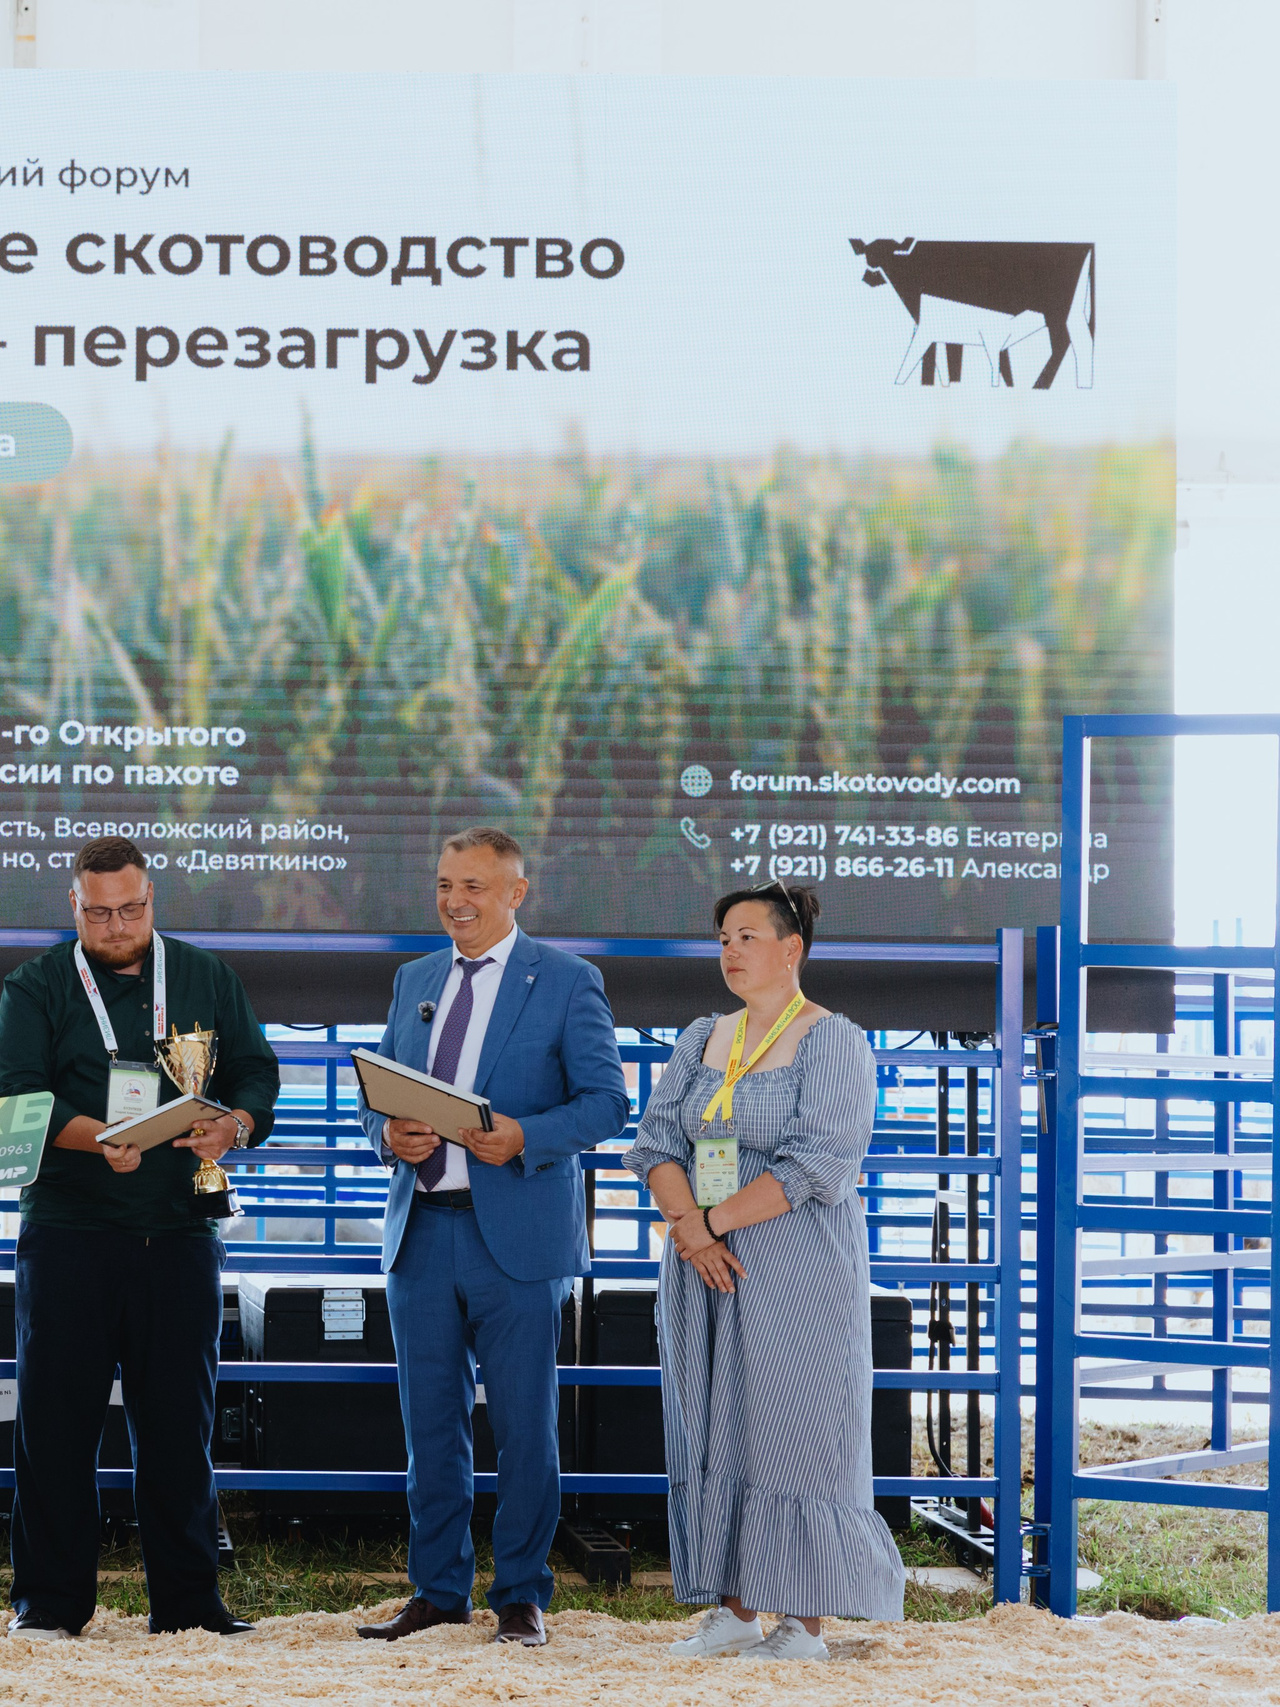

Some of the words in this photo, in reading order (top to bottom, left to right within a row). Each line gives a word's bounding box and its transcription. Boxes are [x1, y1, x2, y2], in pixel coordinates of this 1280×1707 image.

[58, 158, 191, 195] форум
[65, 230, 626, 287] скотоводство
[33, 324, 592, 386] перезагрузка
[58, 719, 247, 751] Открытого
[71, 763, 115, 785] по
[123, 764, 240, 787] пахоте
[730, 769, 1021, 799] forum.skotovody.com
[53, 816, 253, 840] Всеволожский
[260, 818, 351, 845] район,
[730, 824, 761, 846] +7
[768, 823, 827, 851] (921)
[834, 825, 960, 848] 741-33-86
[966, 826, 1109, 854] Екатера
[175, 849, 348, 874] «Девяткино»
[730, 855, 761, 877] +7
[768, 855, 827, 882] (921)
[834, 856, 955, 879] 866-26-11
[961, 857, 1110, 885] Алексар
